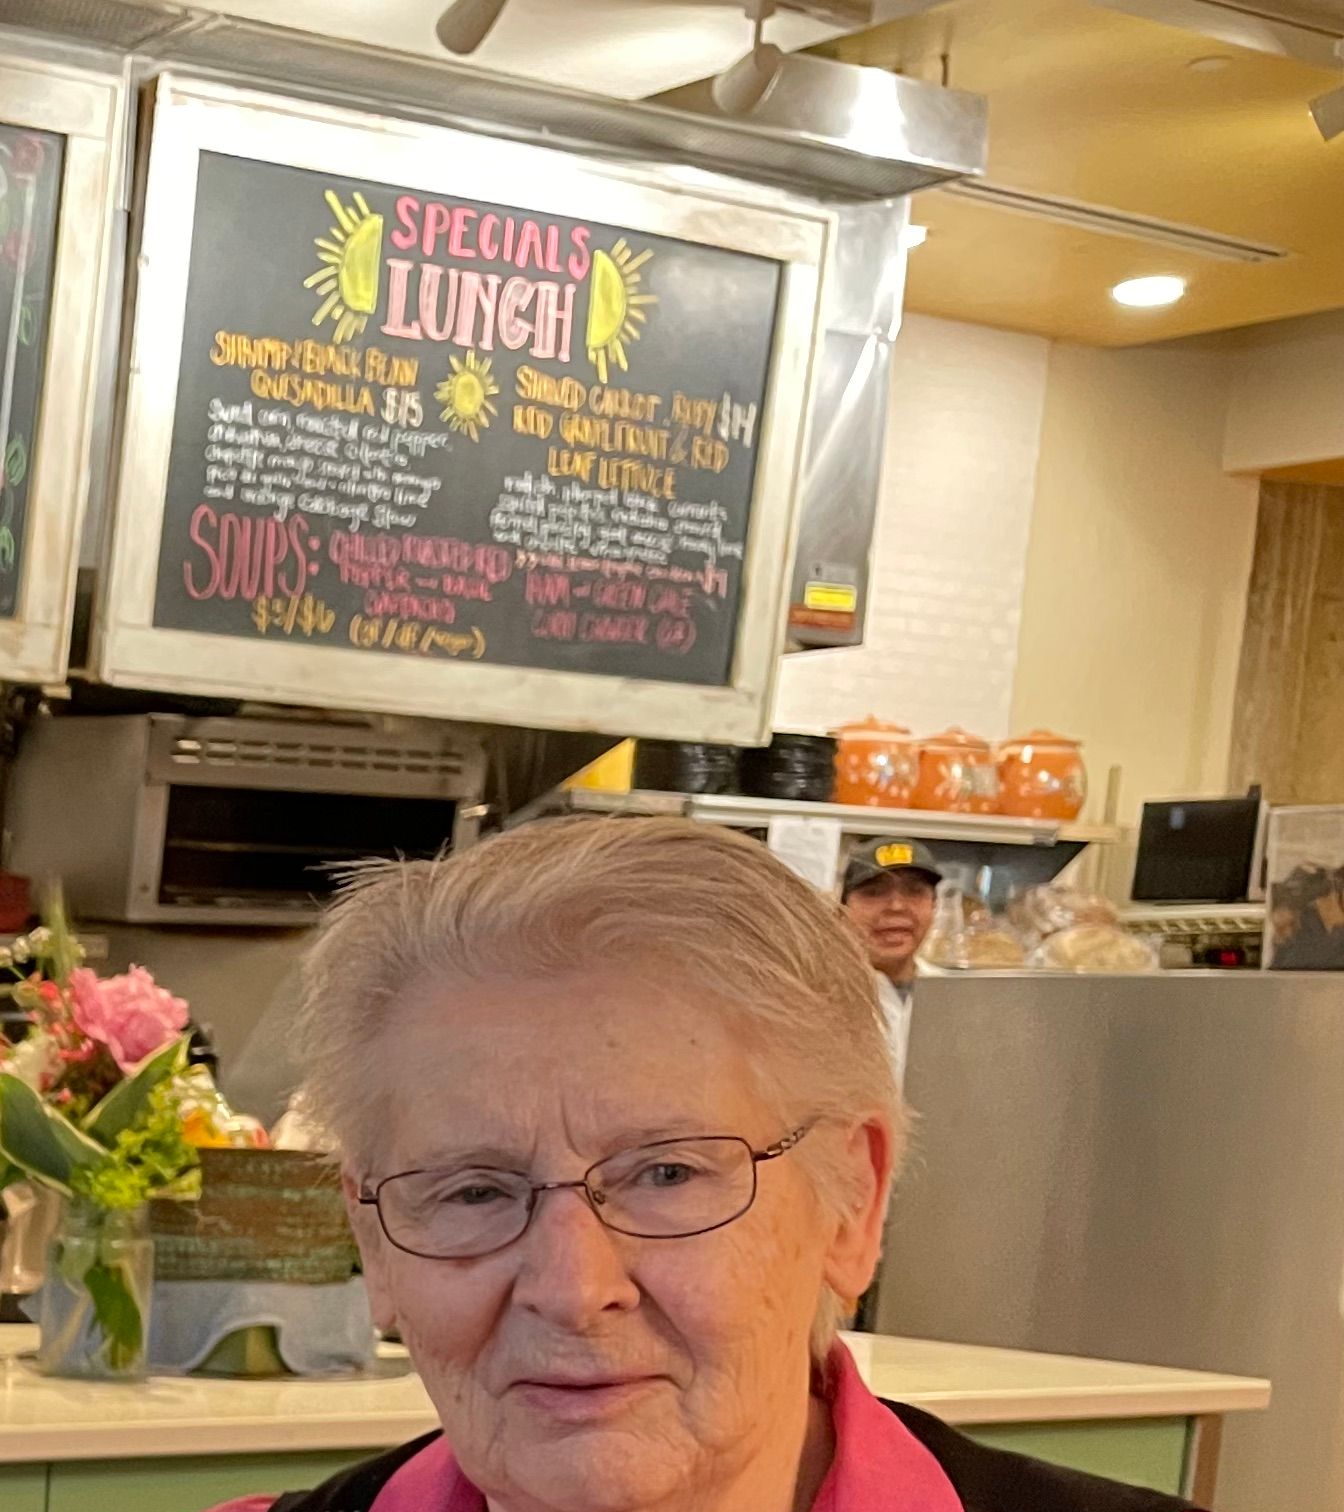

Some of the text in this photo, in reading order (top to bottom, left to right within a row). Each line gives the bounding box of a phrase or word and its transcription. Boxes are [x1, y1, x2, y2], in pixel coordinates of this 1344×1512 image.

[391, 195, 591, 281] SPECIALS
[380, 257, 577, 363] LUNCH
[380, 387, 424, 429] $15
[183, 503, 321, 601] SOUPS:
